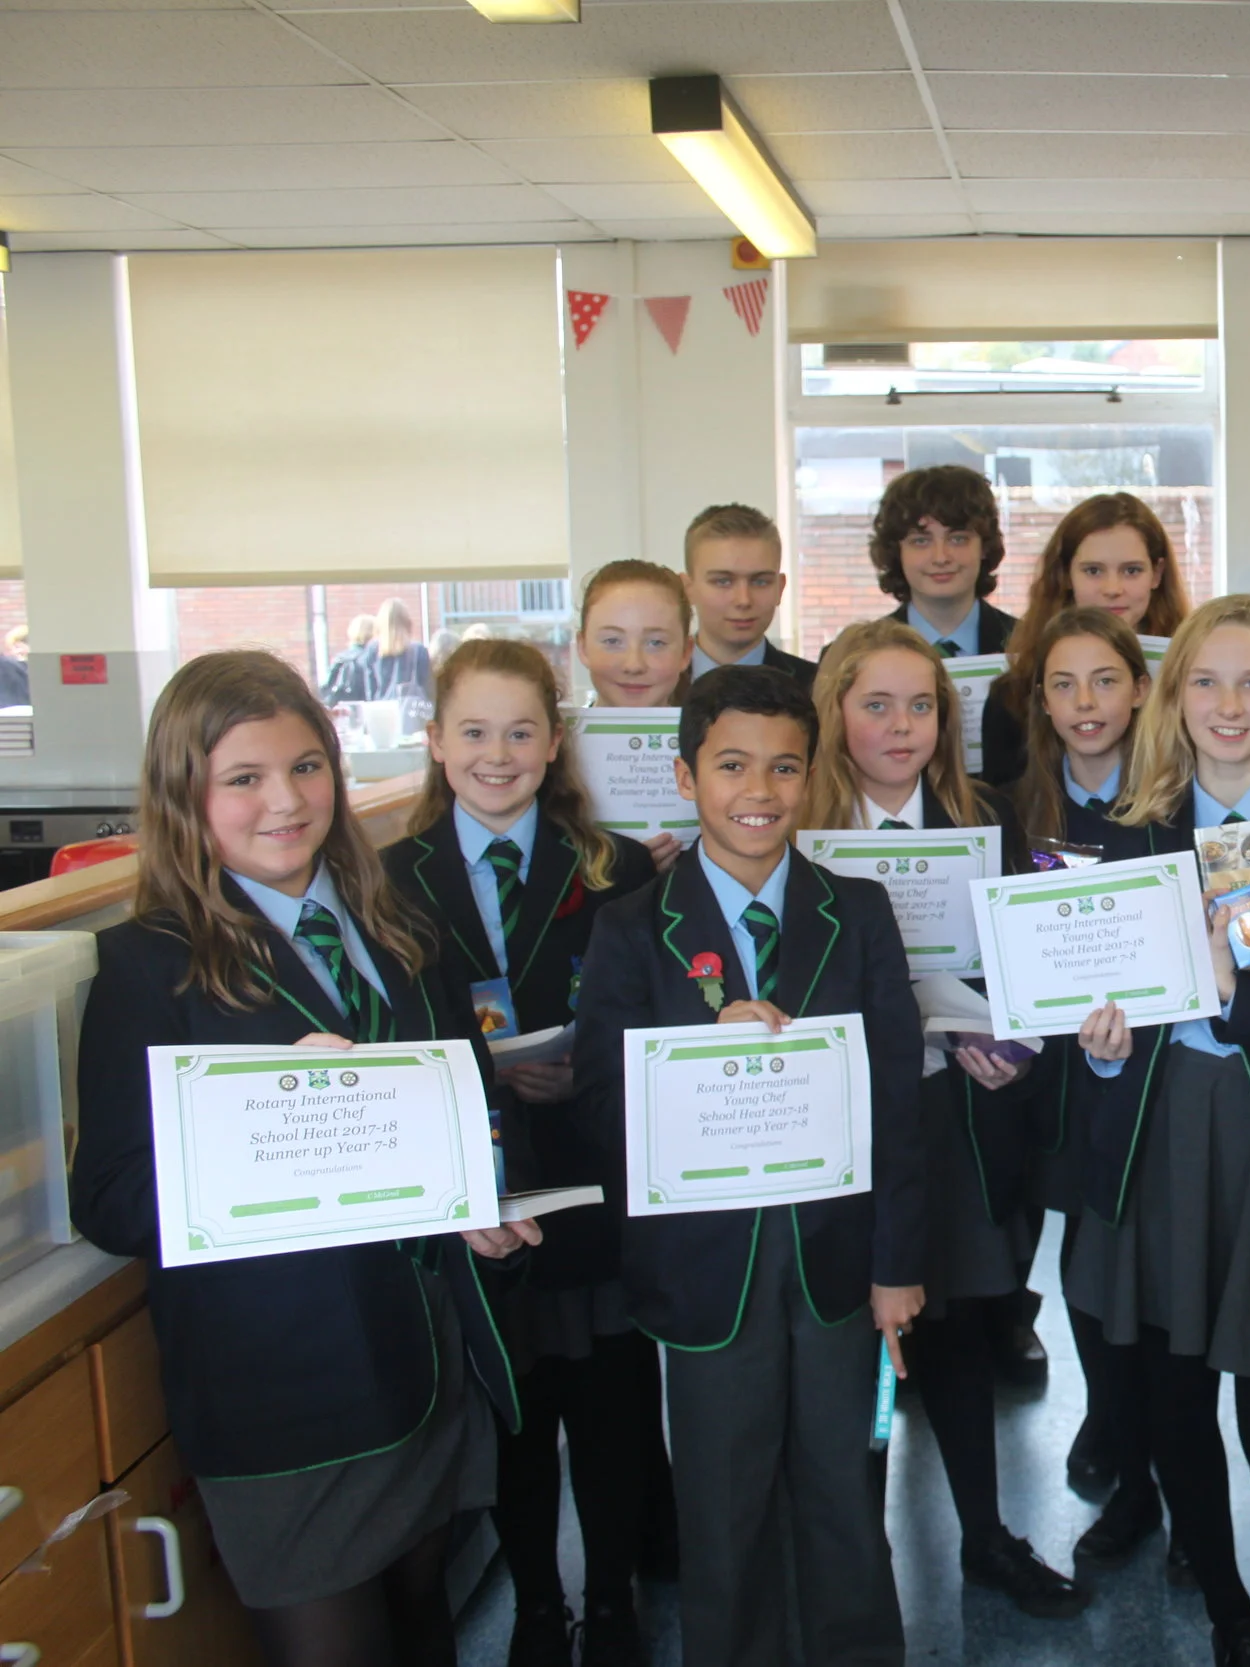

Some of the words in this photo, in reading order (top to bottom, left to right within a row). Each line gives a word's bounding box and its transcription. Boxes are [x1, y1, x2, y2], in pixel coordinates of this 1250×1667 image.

[888, 876, 949, 886] International
[907, 888, 928, 898] Chef
[1035, 922, 1072, 934] Rotary
[1074, 911, 1143, 929] International
[1061, 930, 1094, 944] Young
[1096, 927, 1121, 940] Chef
[1041, 946, 1076, 959] School
[1077, 943, 1102, 954] Heat
[1104, 937, 1145, 951] 2017-18
[1053, 957, 1091, 969] Winner
[1093, 955, 1117, 966] year
[1119, 951, 1137, 964] 7-8
[696, 1082, 736, 1095] Rotary
[738, 1075, 810, 1091] International
[244, 1097, 296, 1112] Rotary
[300, 1088, 397, 1107] International
[724, 1095, 759, 1107] Young
[762, 1091, 787, 1104] Chef
[282, 1111, 329, 1125] Young
[332, 1106, 367, 1121] Chef
[698, 1111, 736, 1123] School
[739, 1109, 766, 1119] Heat
[768, 1103, 809, 1117] 2017-18
[249, 1130, 299, 1146] School
[303, 1127, 338, 1140] Heat
[342, 1120, 398, 1137] 2017-18
[701, 1125, 743, 1137] Runner
[747, 1124, 761, 1136] up
[764, 1121, 788, 1132] Year
[791, 1118, 808, 1130] 7-8
[254, 1146, 310, 1163] Runner
[313, 1146, 333, 1158] up
[336, 1140, 370, 1154] Year
[374, 1136, 398, 1152] 7-8
[293, 1162, 363, 1178] Congratulations
